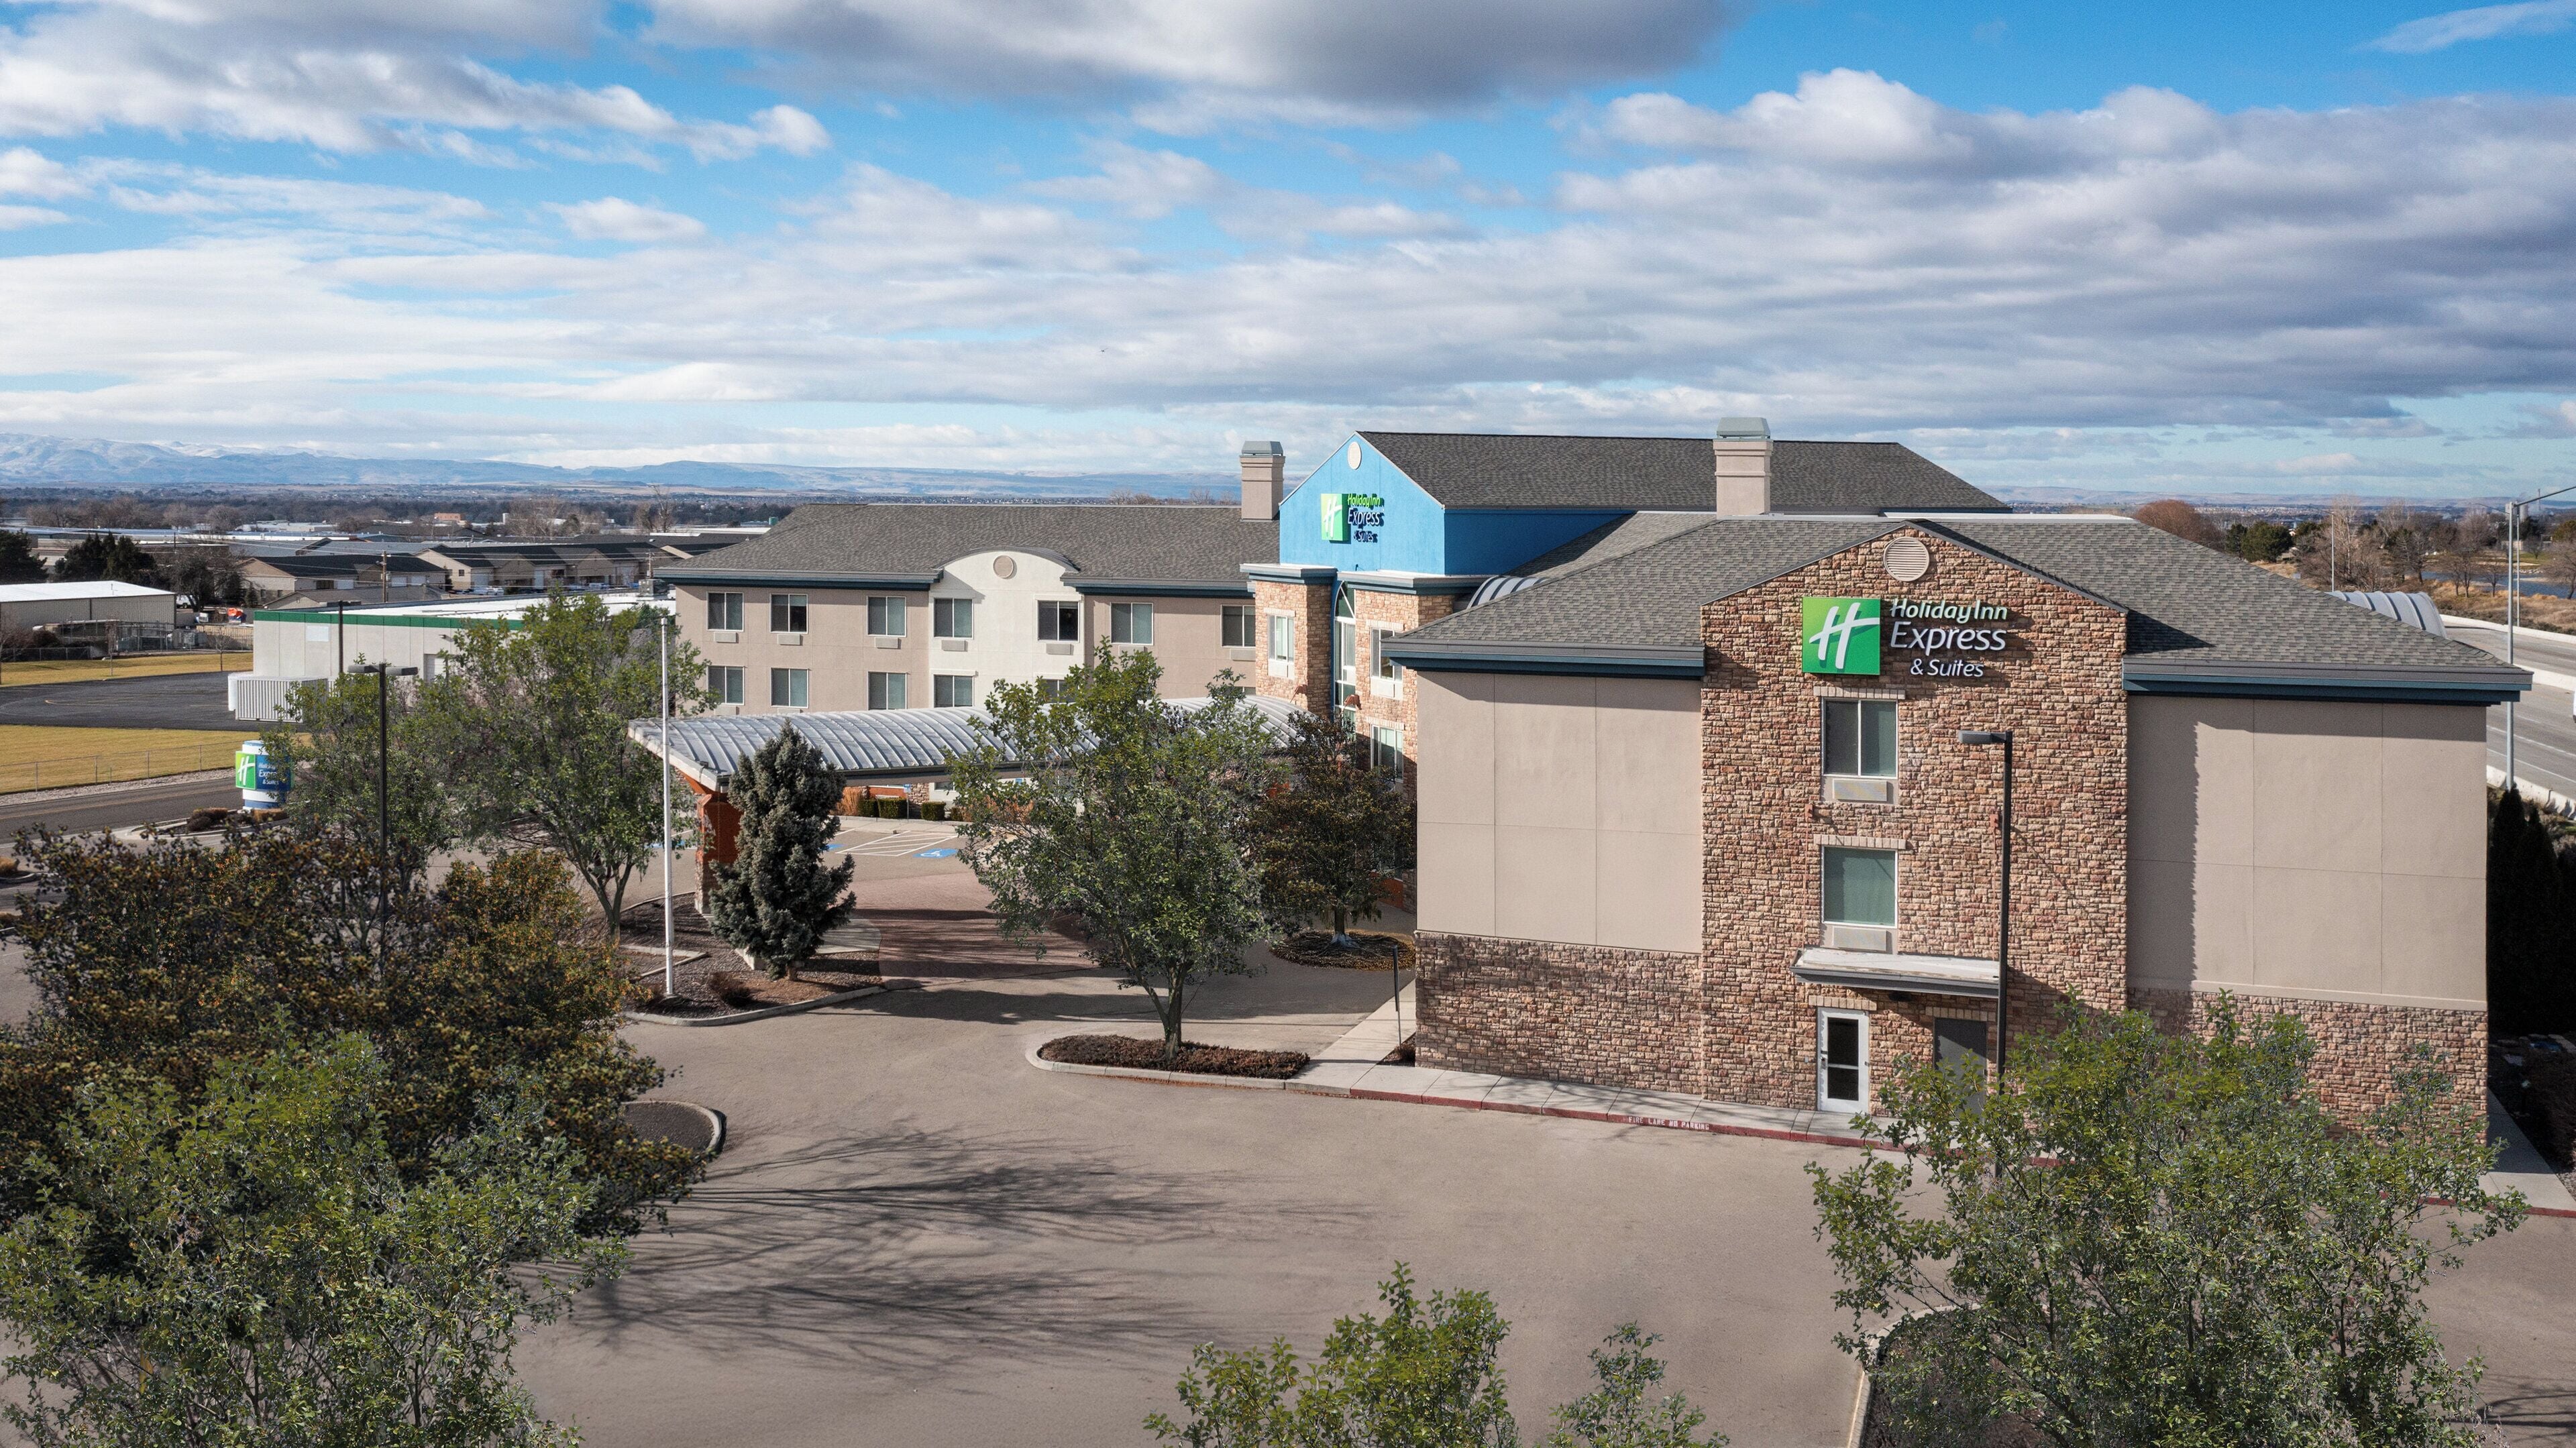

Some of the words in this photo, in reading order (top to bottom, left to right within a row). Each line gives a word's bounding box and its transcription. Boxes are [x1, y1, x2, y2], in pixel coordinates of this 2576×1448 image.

[1348, 507, 1381, 528] Express
[1890, 598, 1972, 624] Holiday
[1974, 600, 2008, 620] Inn
[1890, 621, 2007, 656] Express
[1911, 658, 1924, 675] &
[1927, 659, 1984, 677] Suites
[1681, 1122, 1709, 1130] PARKING
